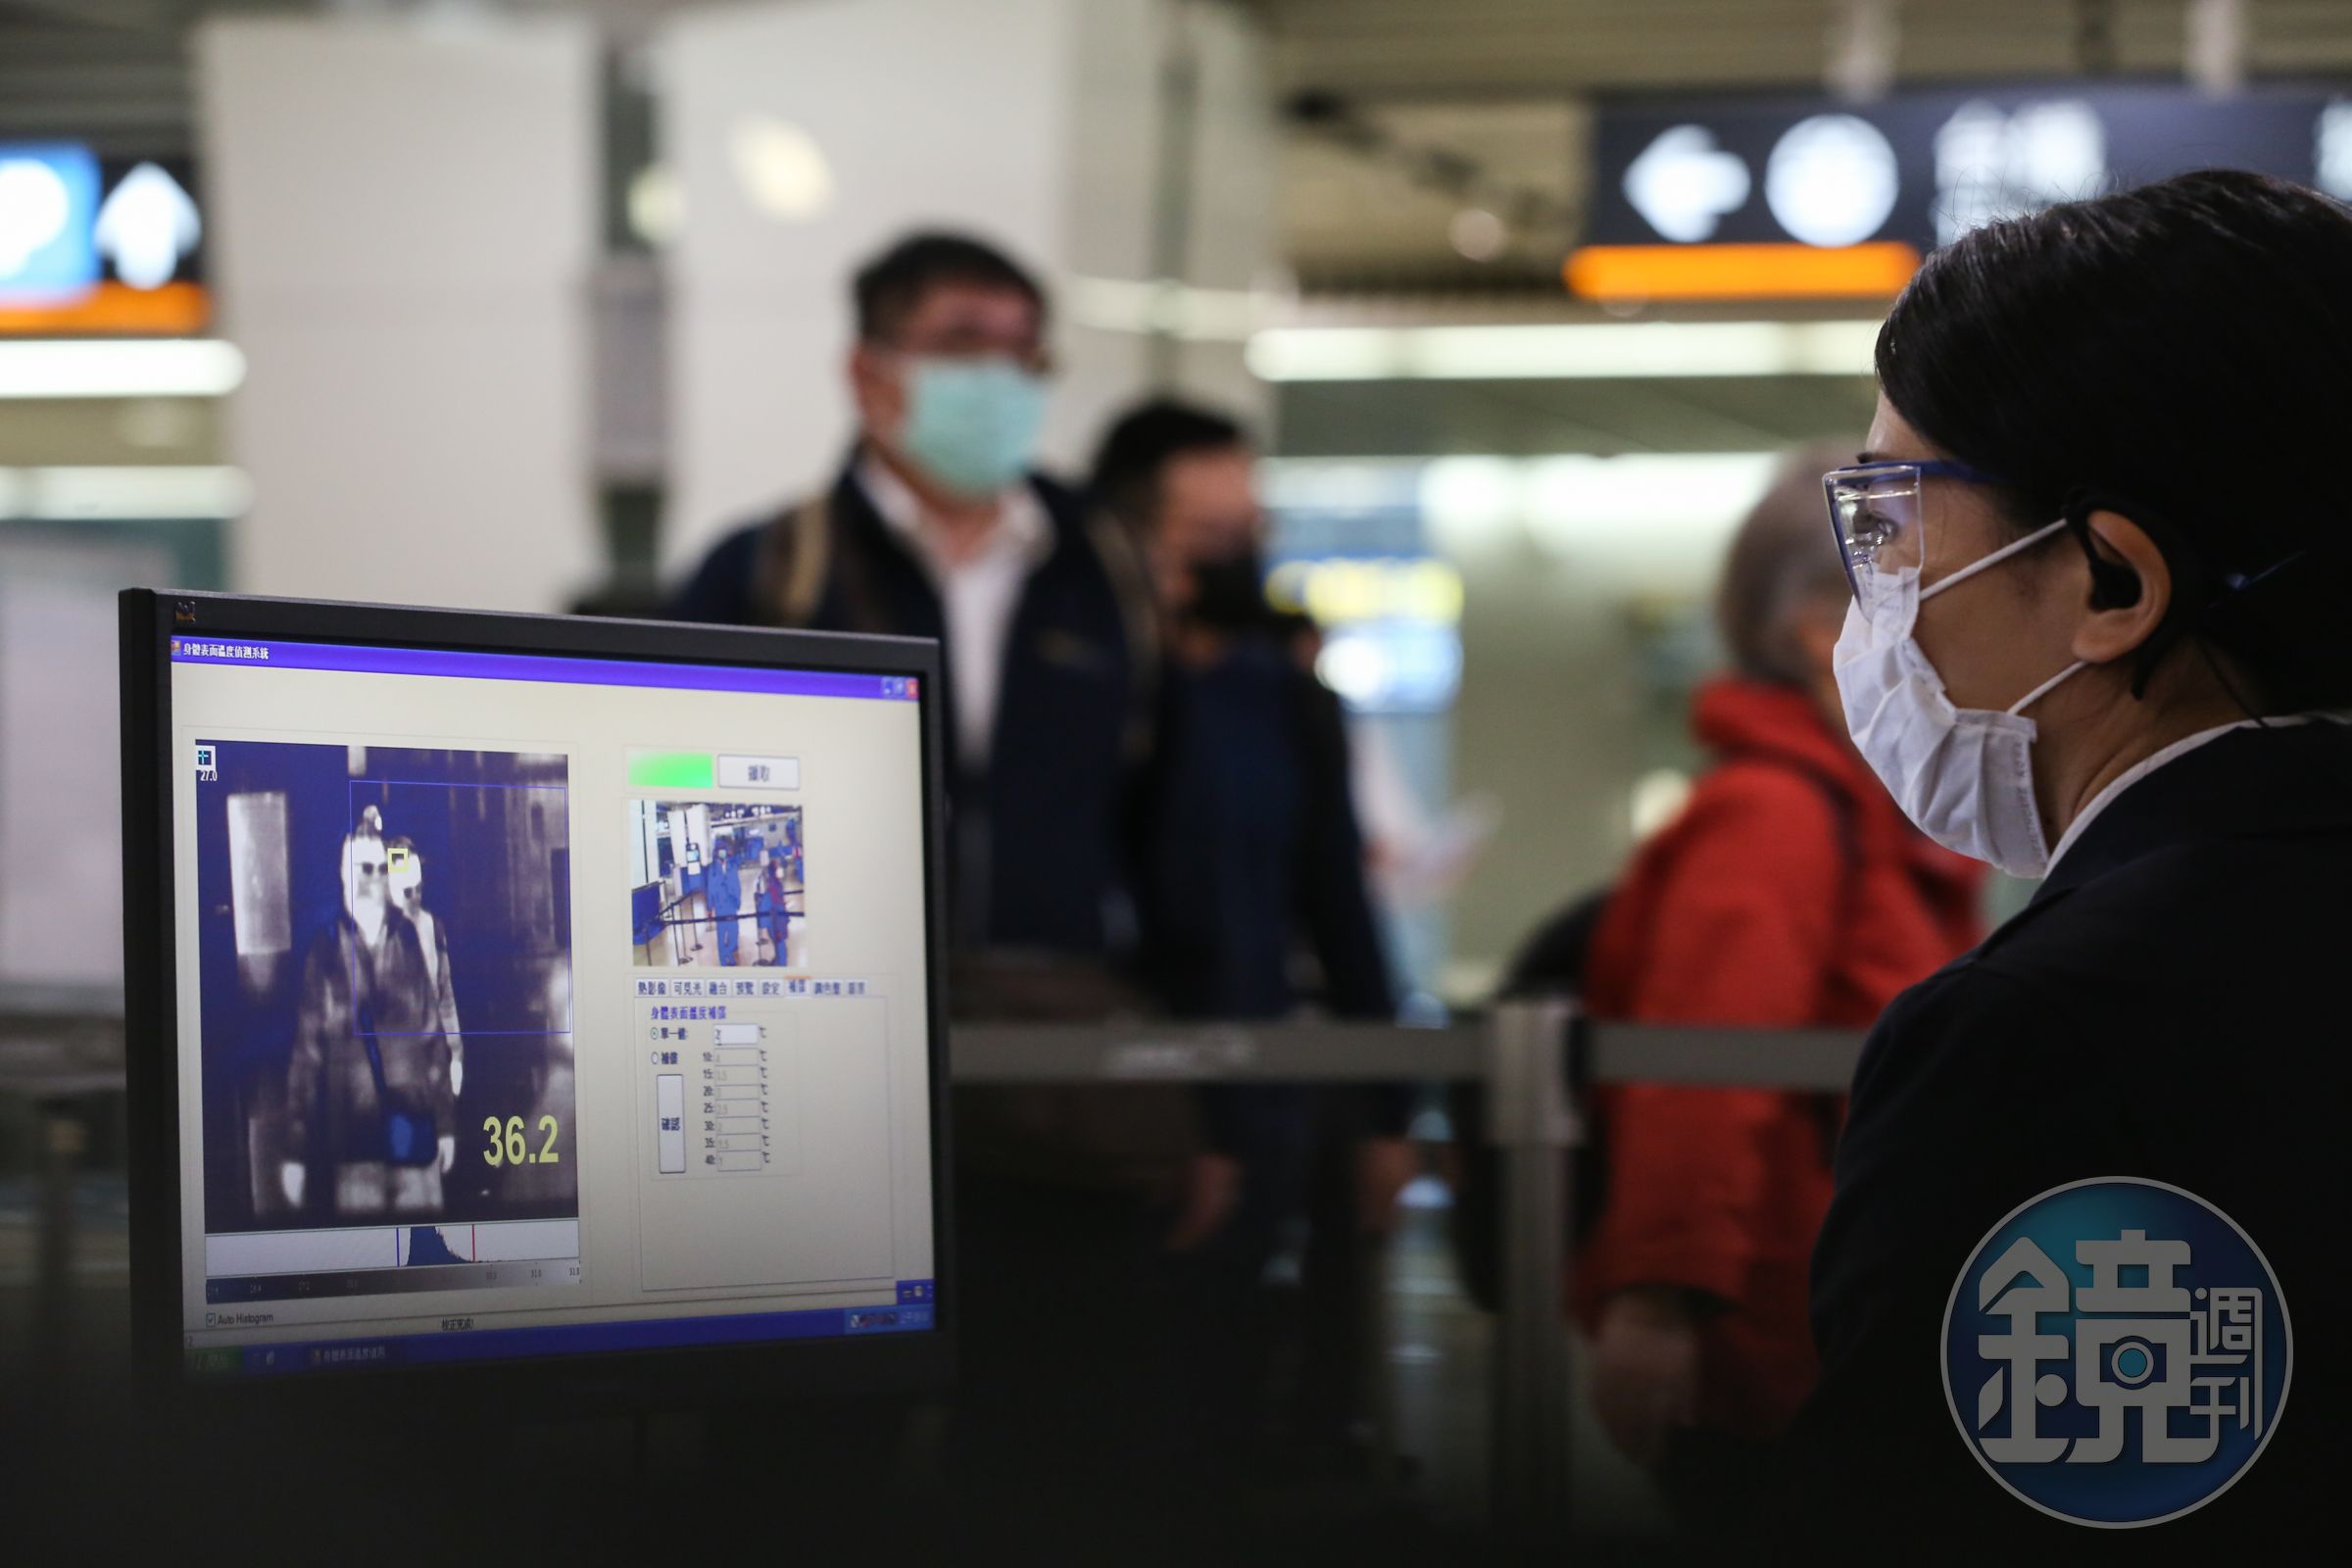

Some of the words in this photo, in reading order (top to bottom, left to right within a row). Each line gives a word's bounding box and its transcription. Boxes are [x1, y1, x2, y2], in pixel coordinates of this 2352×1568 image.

[183, 643, 269, 660] 身體表面溫度偵測系統
[674, 981, 702, 996] 可見光
[482, 1114, 560, 1166] 36.2
[217, 1315, 235, 1326] Auto
[236, 1312, 274, 1326] Histogram
